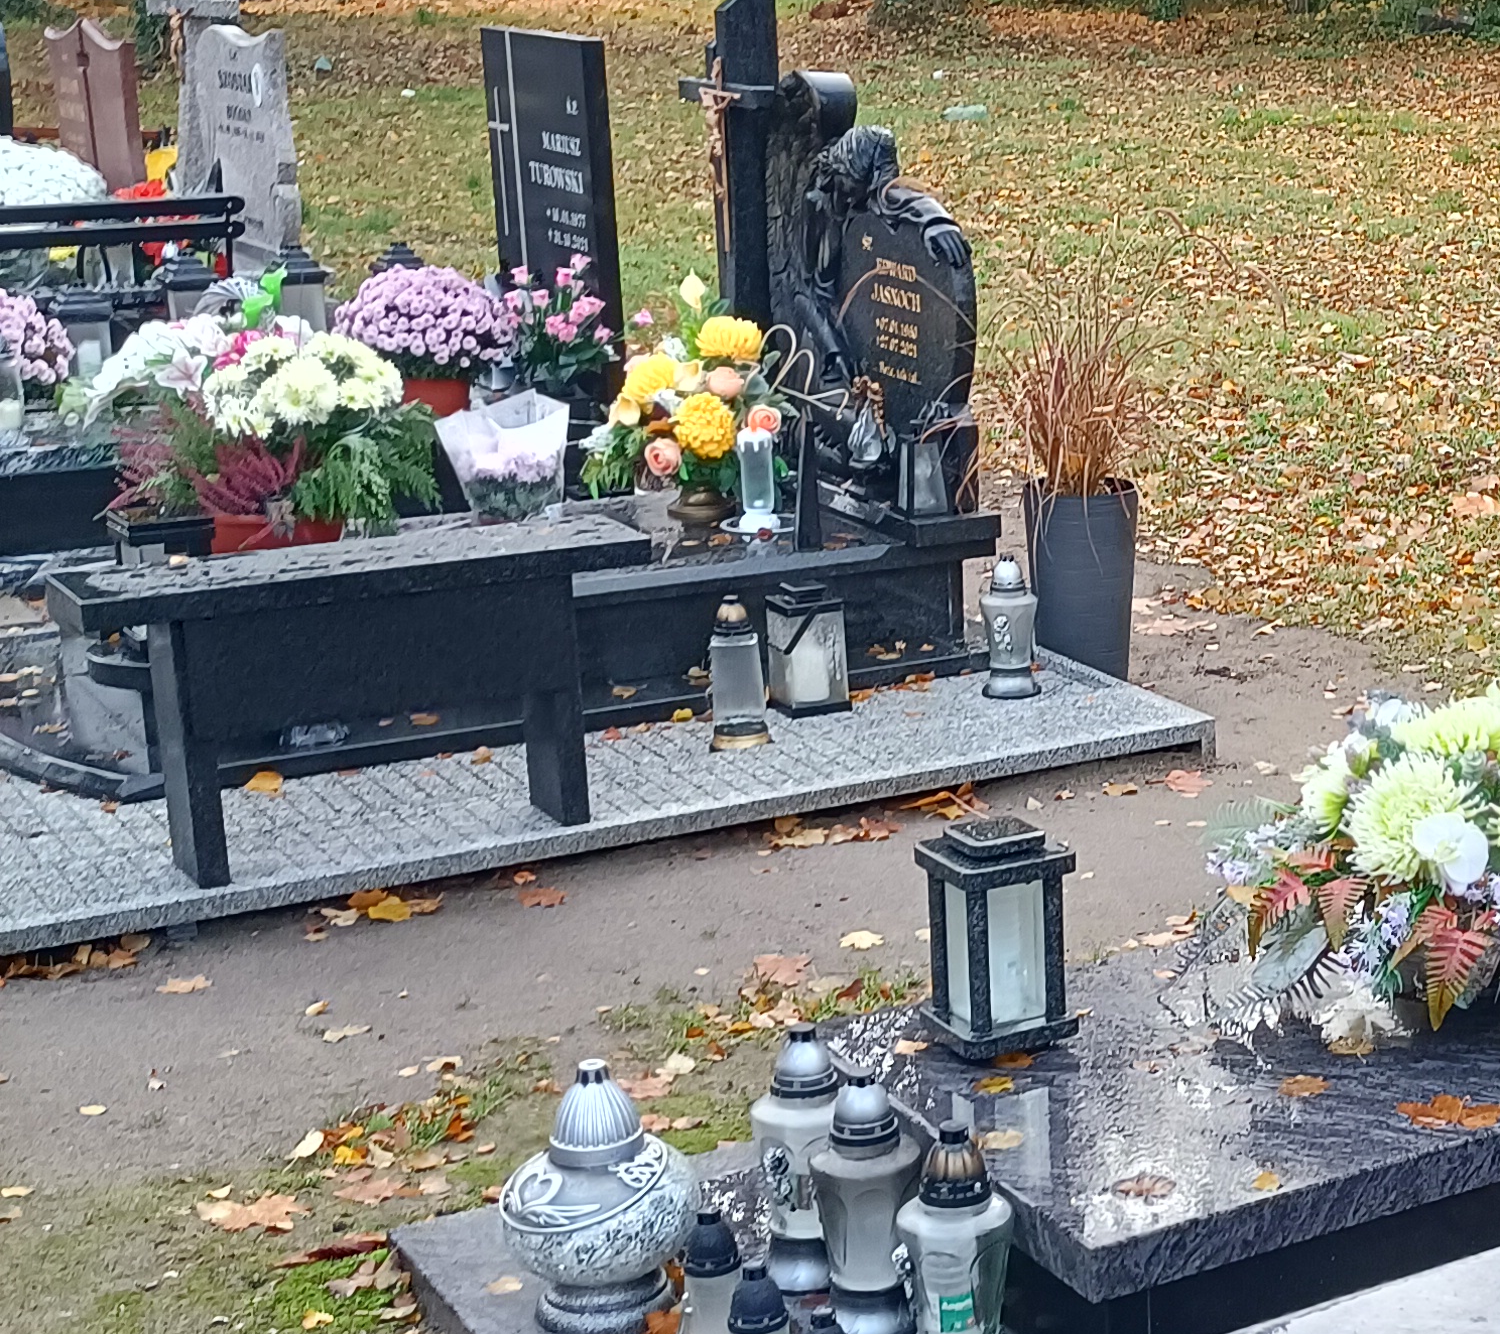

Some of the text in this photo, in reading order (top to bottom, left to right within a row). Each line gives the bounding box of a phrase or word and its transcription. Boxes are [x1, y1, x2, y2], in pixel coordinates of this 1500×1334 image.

[541, 131, 582, 156] MARIUSZ
[529, 161, 584, 194] TUROWSKI
[870, 283, 921, 313] JASNOCH
